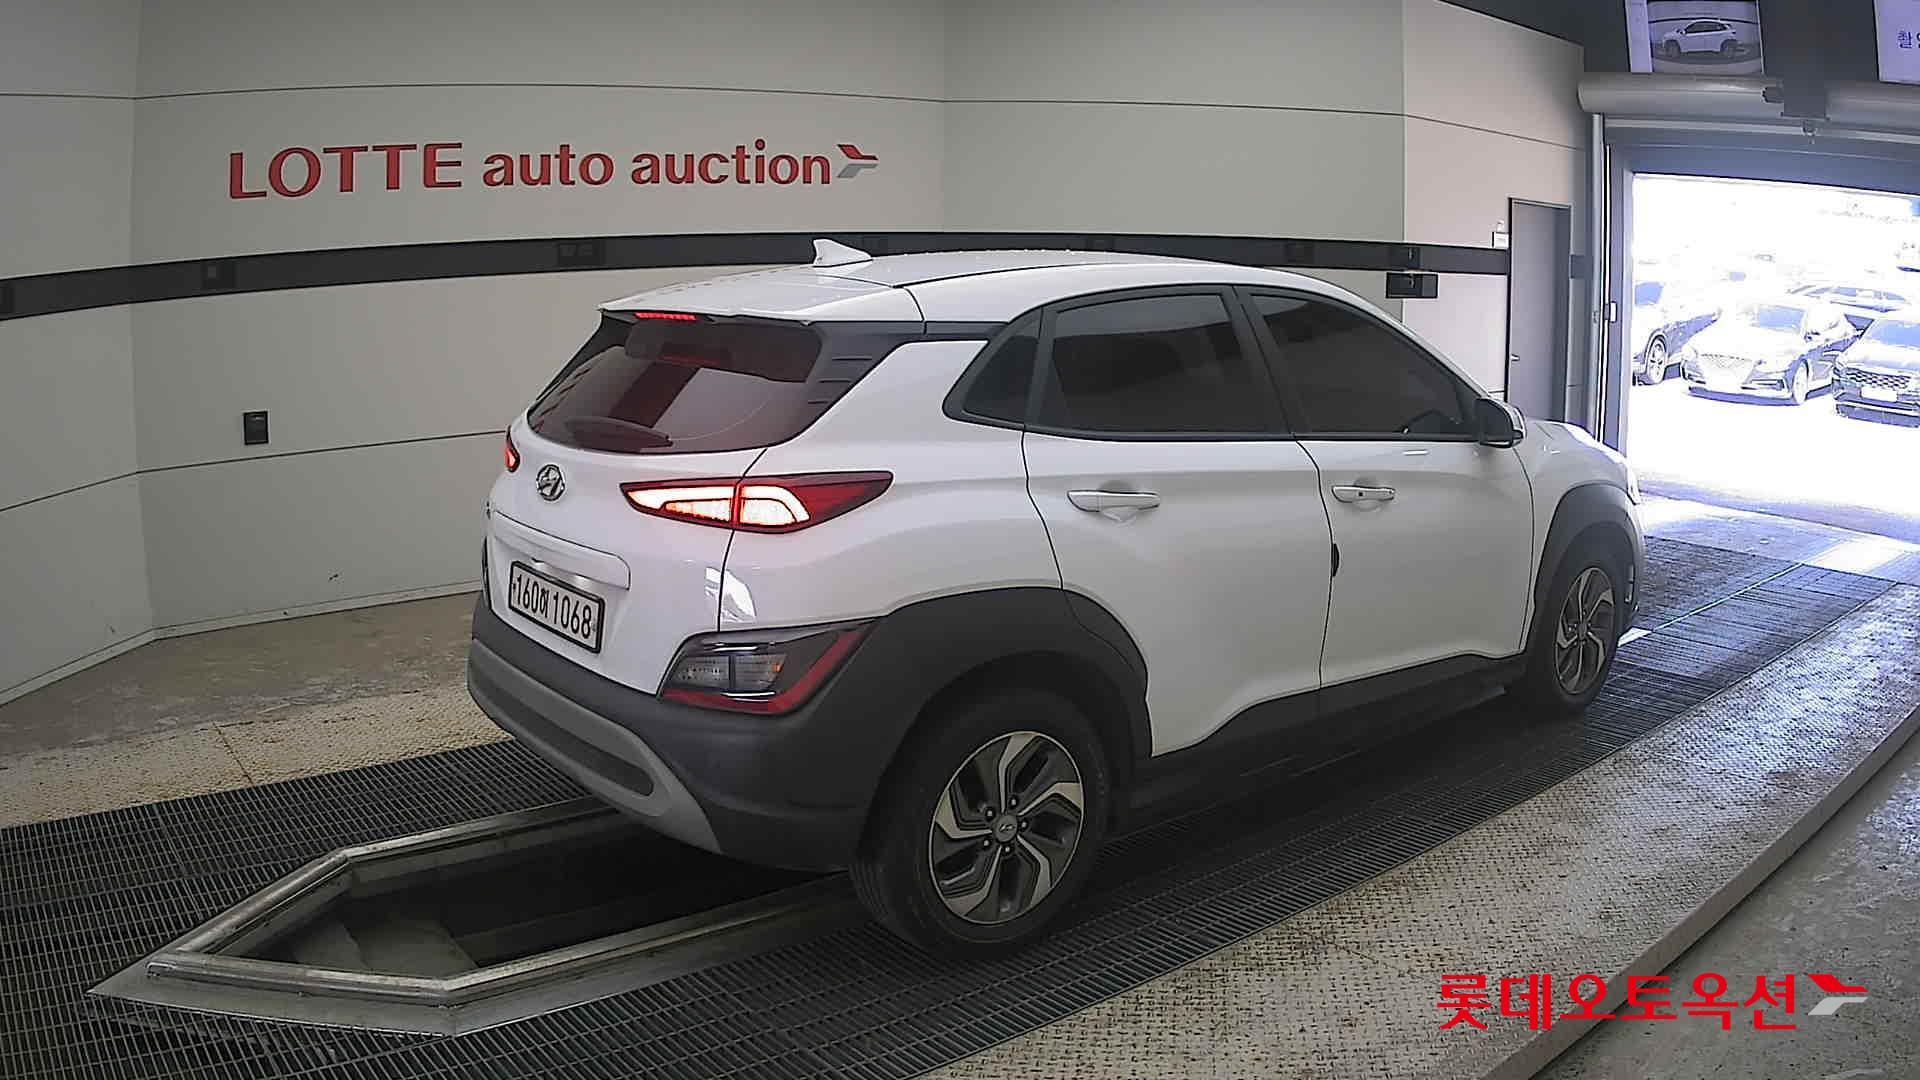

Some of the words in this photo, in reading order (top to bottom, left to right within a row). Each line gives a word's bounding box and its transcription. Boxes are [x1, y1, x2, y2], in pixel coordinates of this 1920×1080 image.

[229, 142, 462, 199] LOTTE
[482, 144, 614, 187] auto
[630, 139, 831, 185] auction
